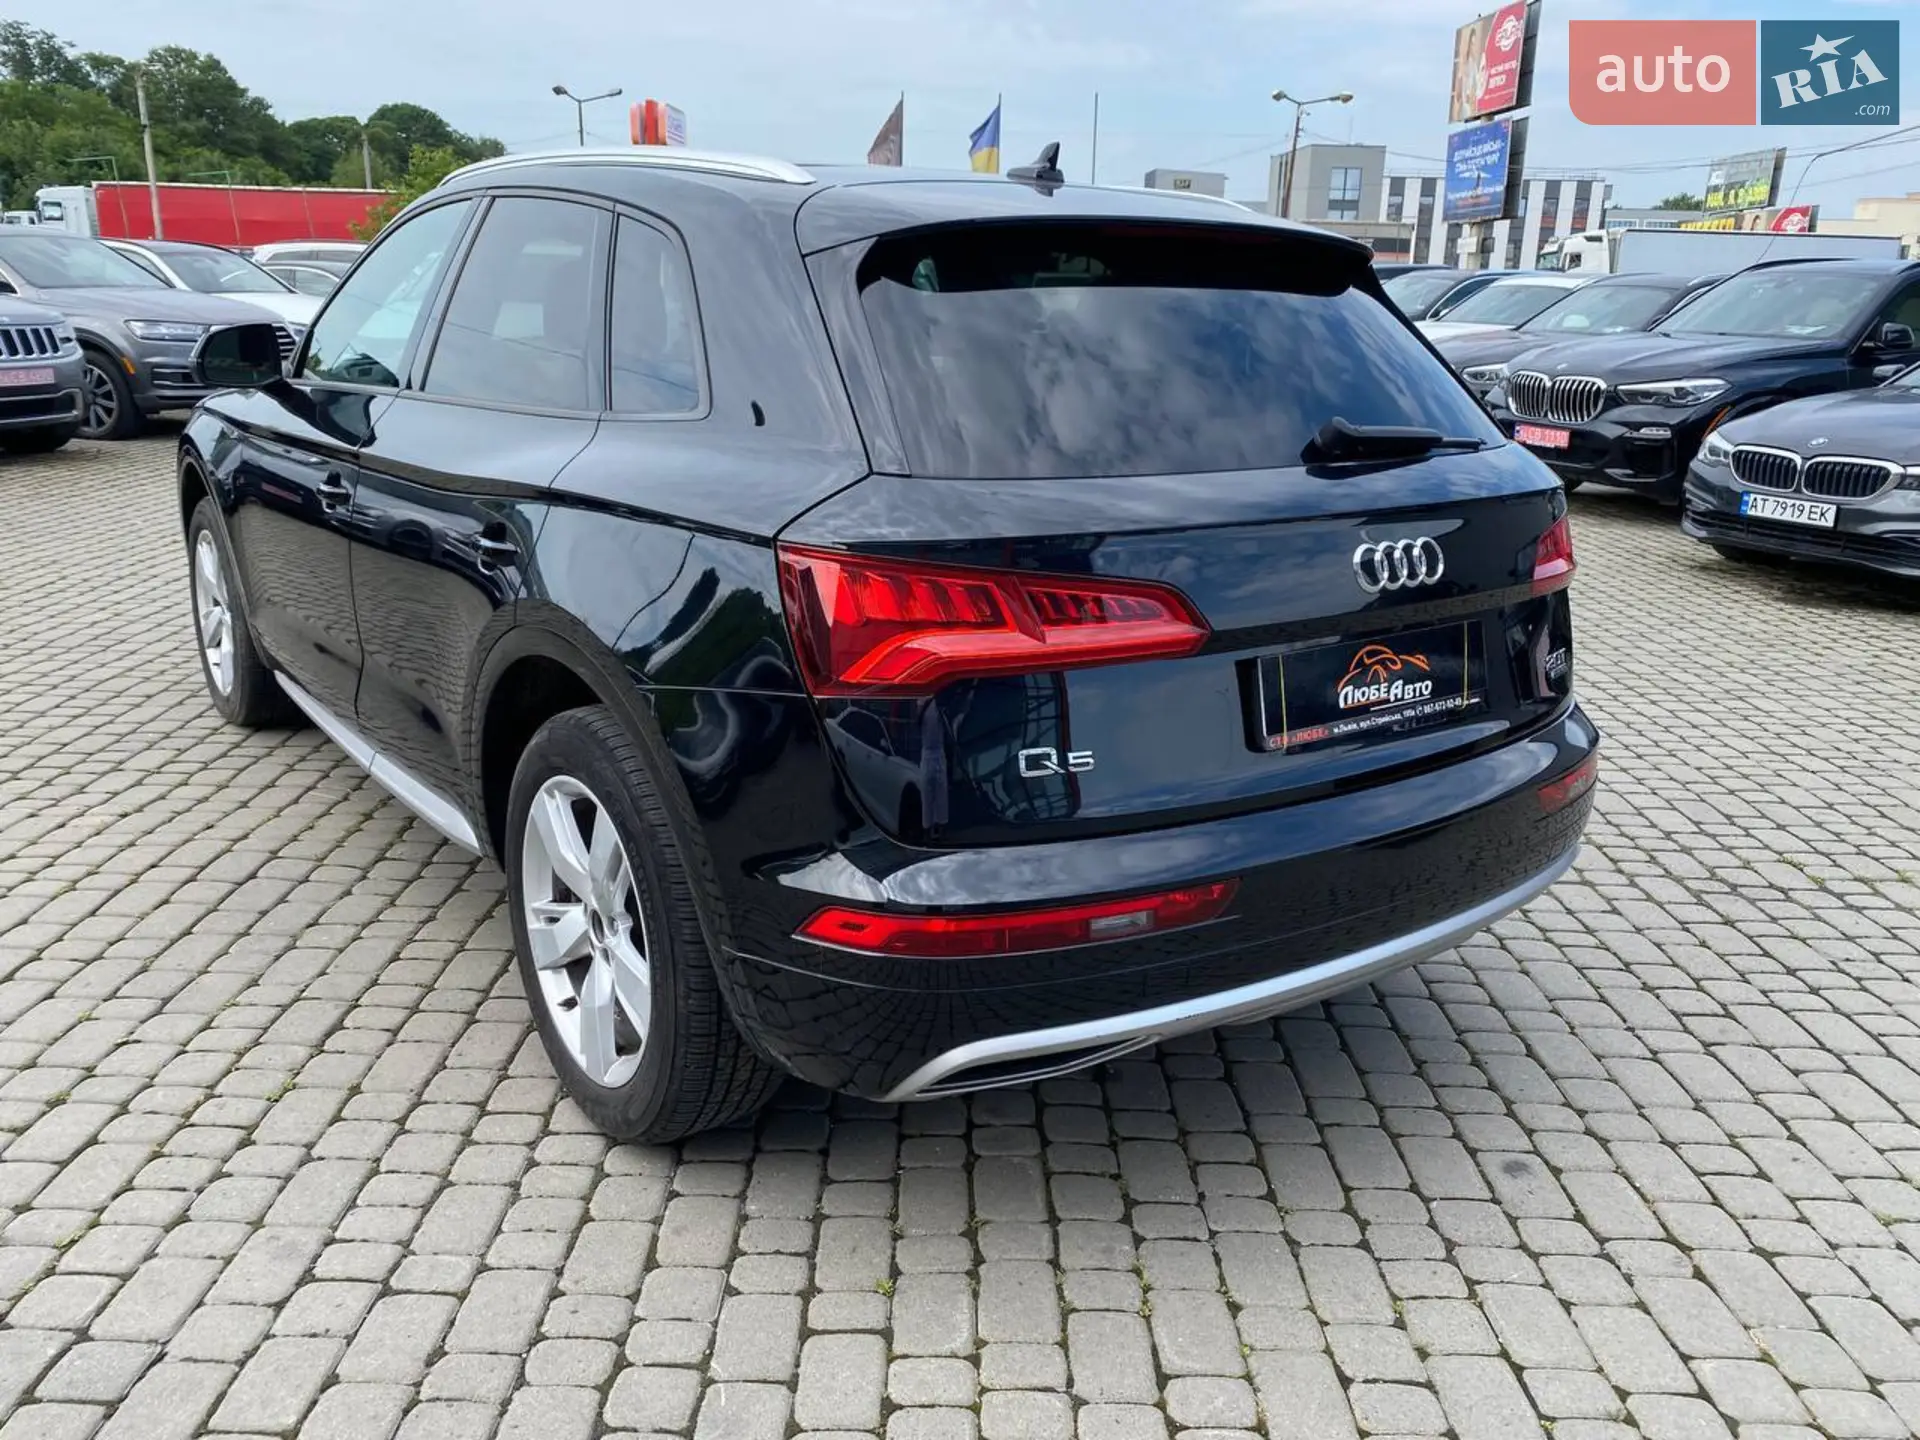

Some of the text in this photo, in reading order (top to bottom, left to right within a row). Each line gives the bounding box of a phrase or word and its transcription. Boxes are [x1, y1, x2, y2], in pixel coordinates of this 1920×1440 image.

[1750, 497, 1831, 522] AT 7919 EK
[1018, 747, 1095, 777] Q5
